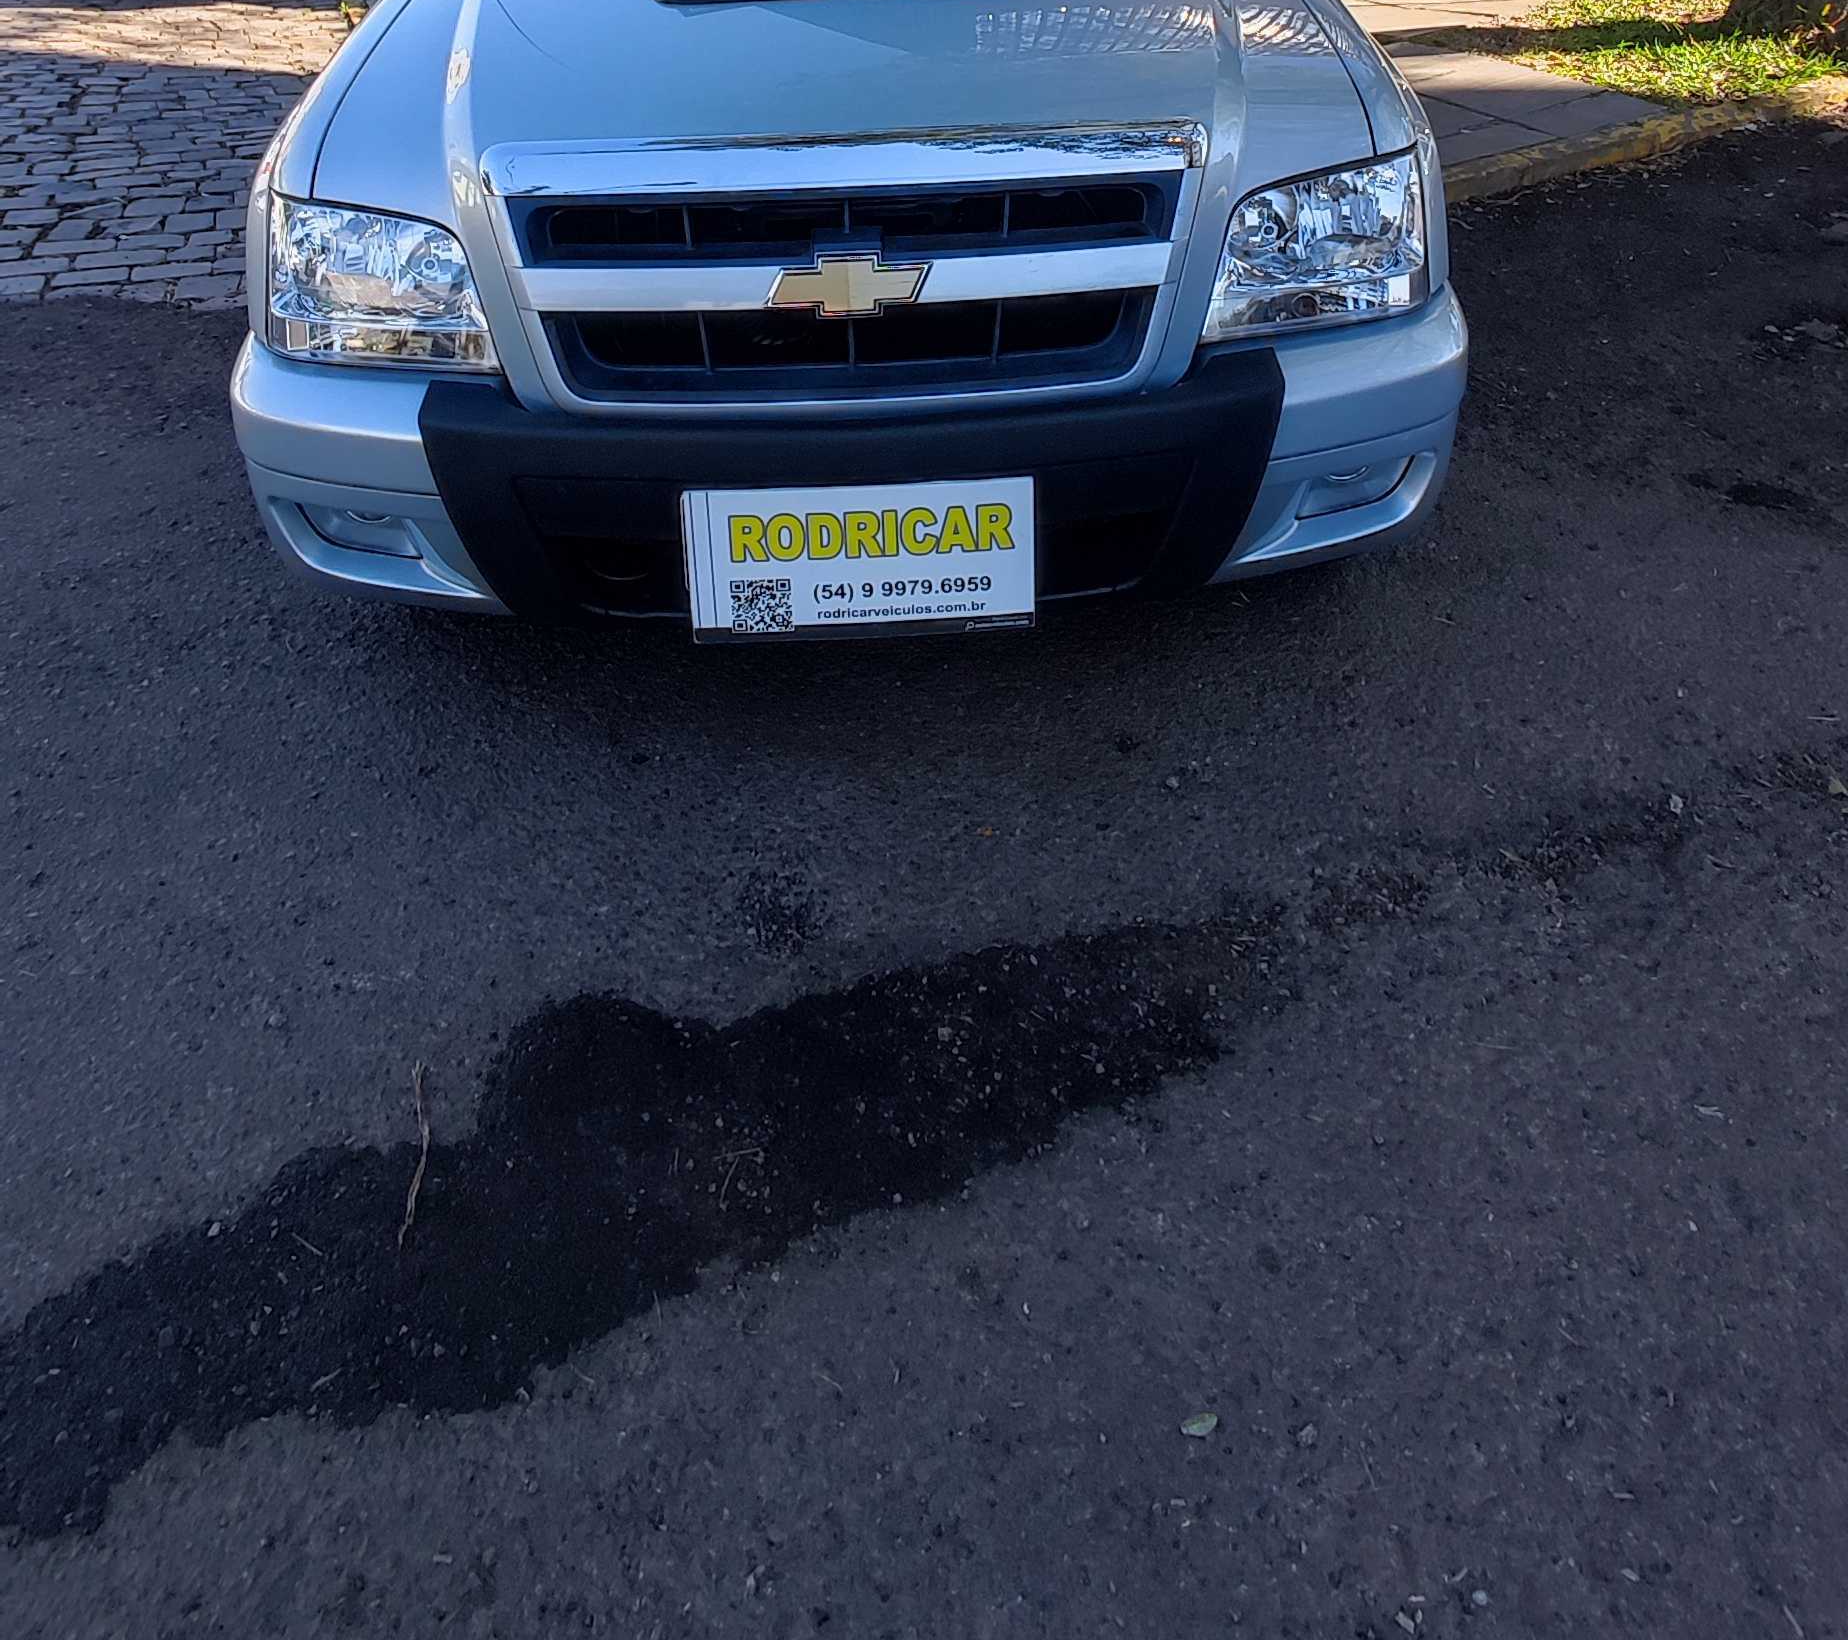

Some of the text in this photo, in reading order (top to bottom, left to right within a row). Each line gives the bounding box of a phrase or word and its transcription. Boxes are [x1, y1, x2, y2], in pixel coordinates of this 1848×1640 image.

[728, 503, 1015, 563] RODRICAR
[813, 575, 992, 605] (54) 9 9979.6959
[817, 600, 987, 620] rodricarveiculos.com.br
